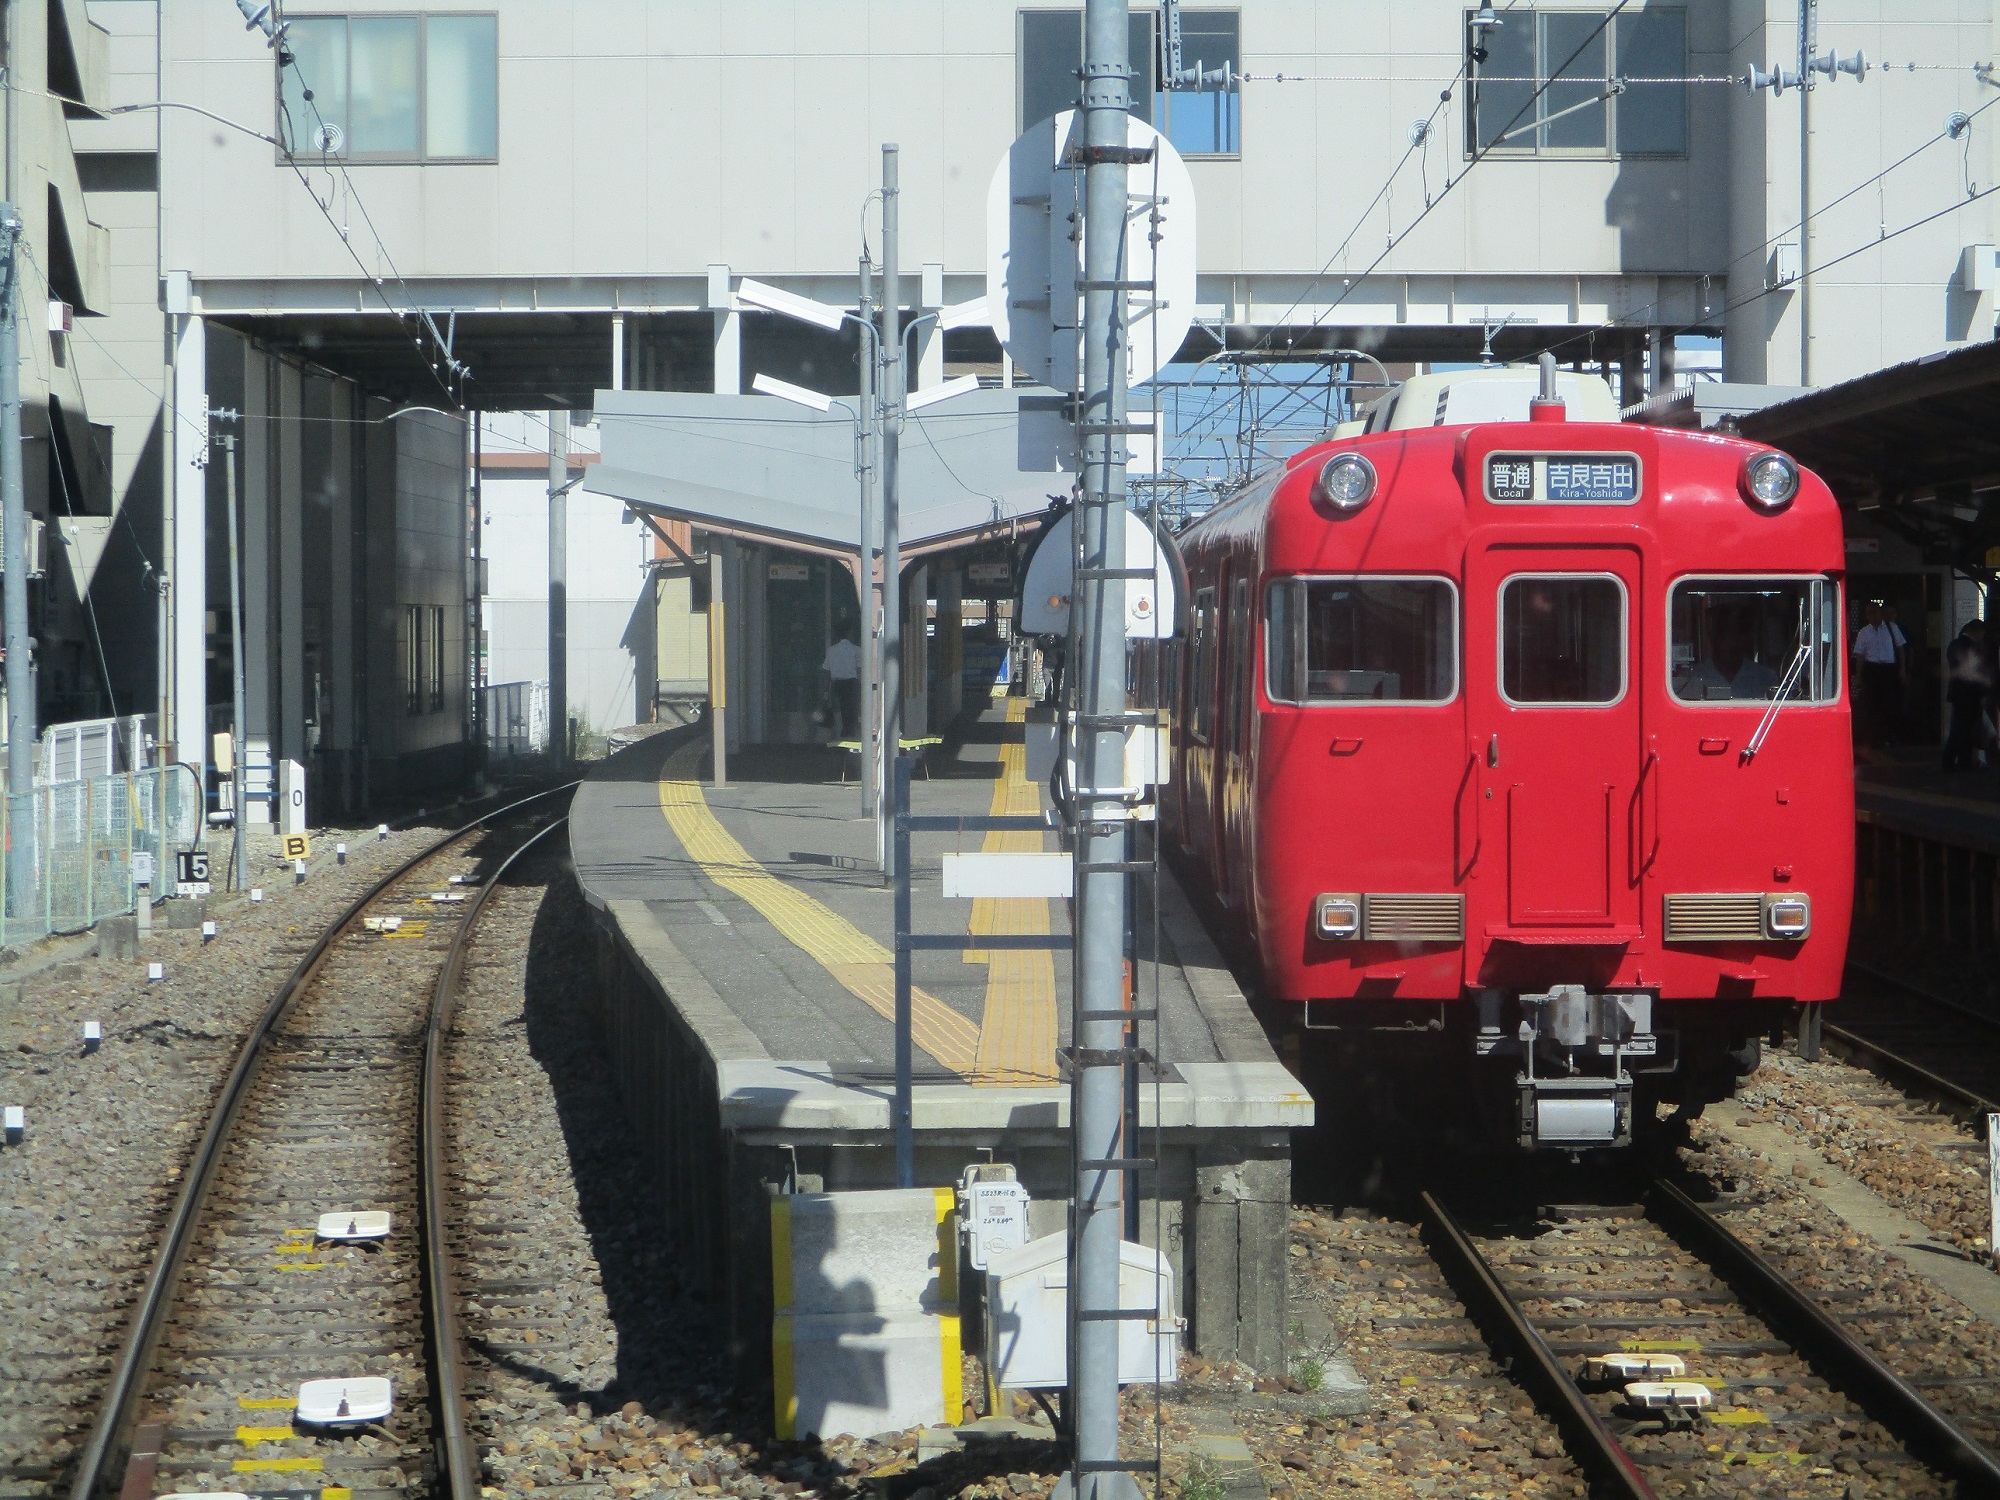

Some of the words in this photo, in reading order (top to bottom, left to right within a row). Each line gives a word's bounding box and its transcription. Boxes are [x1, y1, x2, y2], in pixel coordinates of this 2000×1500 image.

[1492, 463, 1530, 488] 普通
[1549, 463, 1633, 488] 吉良吉田
[1498, 489, 1524, 498] Local
[1560, 489, 1623, 498] Kira-Yoshida
[287, 838, 305, 855] B
[179, 855, 208, 880] 15
